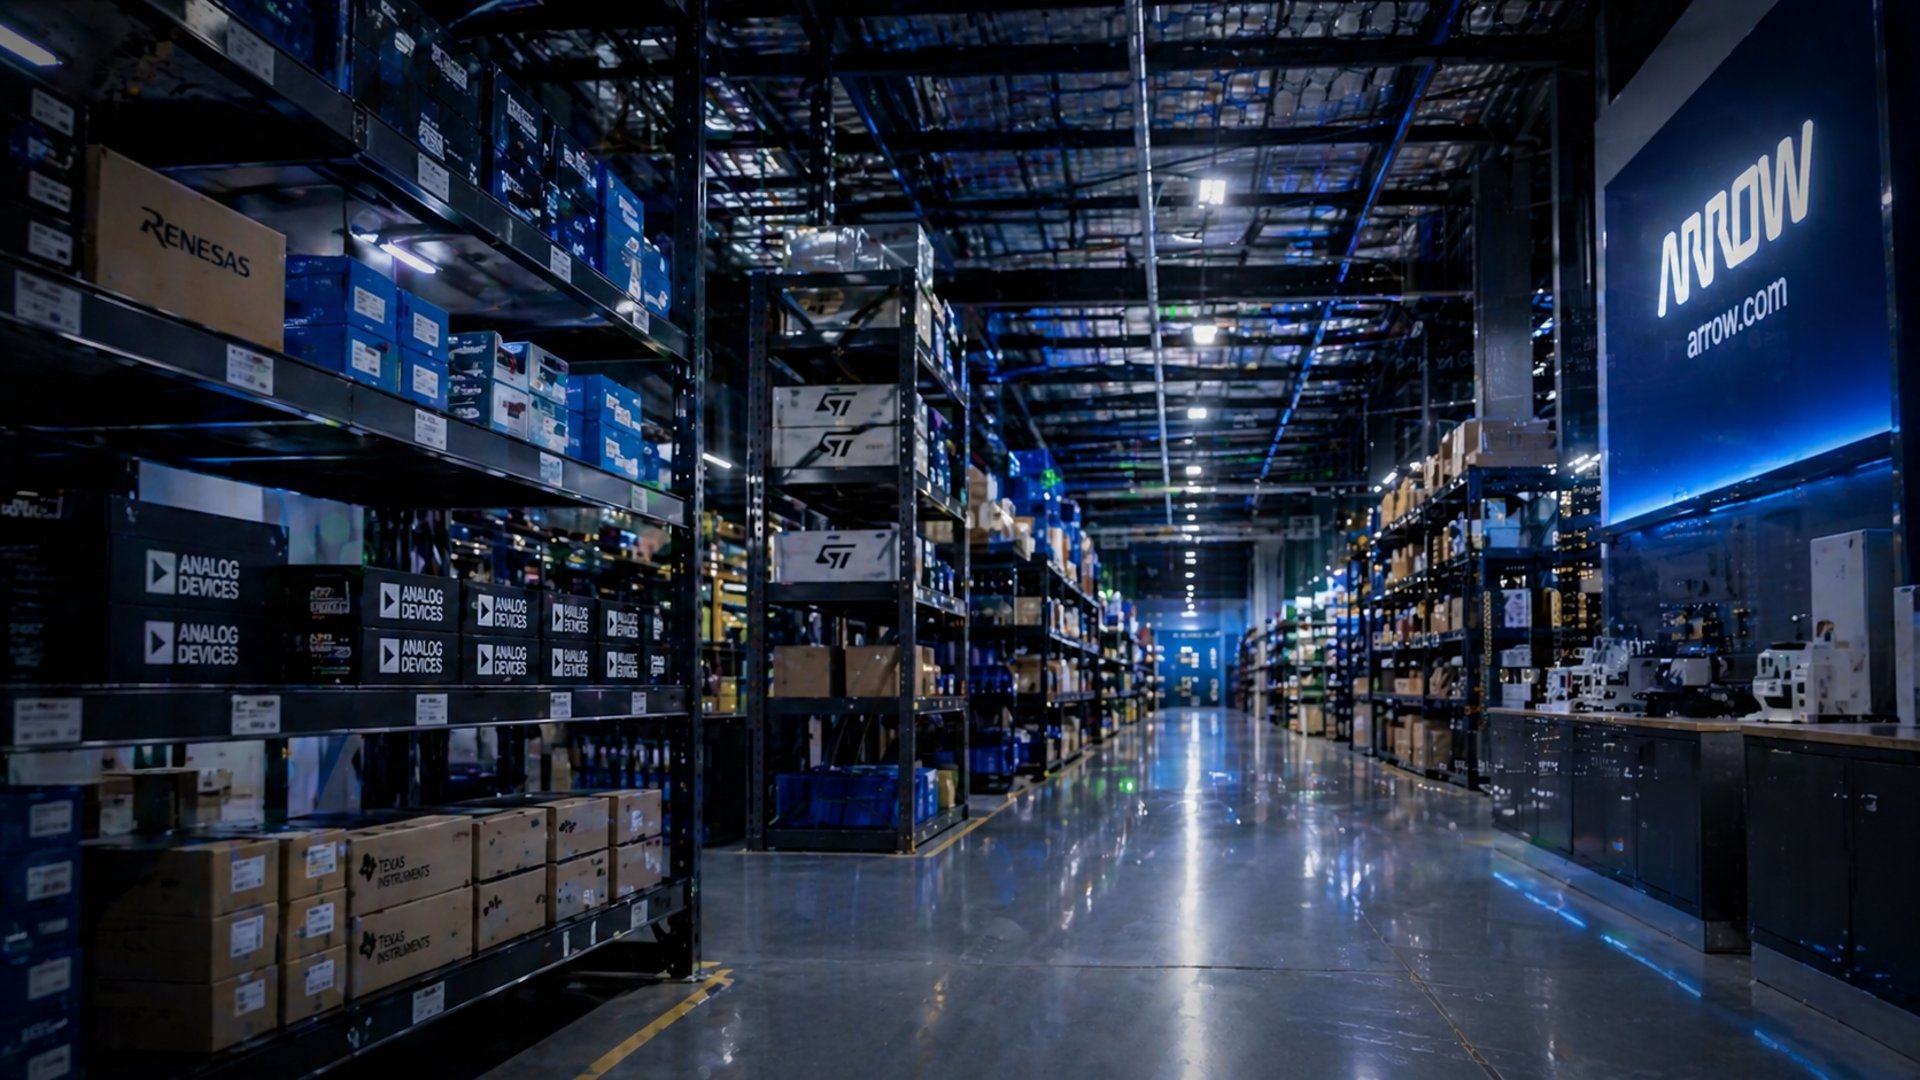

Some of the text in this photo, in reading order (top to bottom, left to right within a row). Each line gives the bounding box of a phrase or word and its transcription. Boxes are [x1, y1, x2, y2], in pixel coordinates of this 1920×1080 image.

[1657, 119, 1814, 318] ARROW
[141, 206, 250, 277] RENESAS
[1687, 276, 1788, 359] arrow.com
[816, 392, 857, 416] ST
[818, 432, 854, 457] ST
[178, 554, 240, 579] ANALOG
[816, 544, 856, 569] ST
[178, 576, 240, 600] DEVICES
[401, 585, 443, 605] ANALOG
[401, 605, 443, 622] DEVICES
[494, 596, 528, 613] ANALOG
[494, 613, 528, 629] DEVICES
[177, 623, 239, 645] ANALOG
[177, 645, 239, 665] DEVICES
[401, 639, 443, 657] ANALOG
[494, 645, 528, 661] ANALOG
[401, 657, 443, 674] DEVICES
[494, 661, 528, 676] DEVICES
[379, 856, 405, 873] TEXAS
[379, 930, 405, 947] TEXAS
